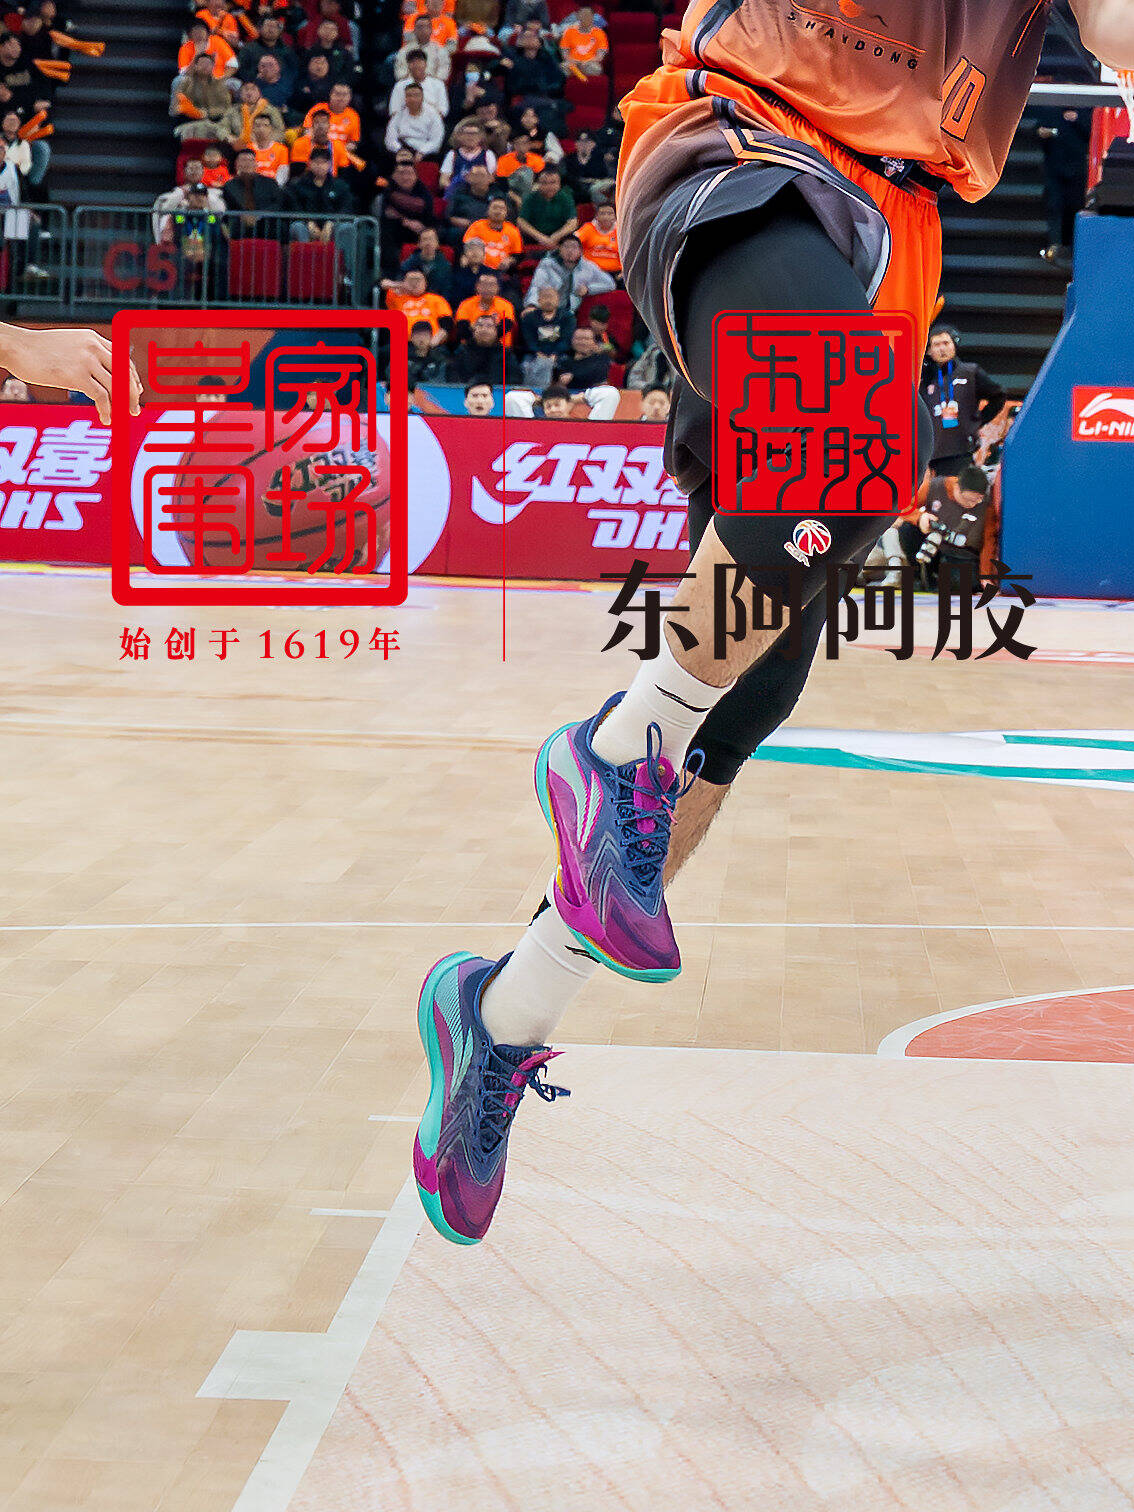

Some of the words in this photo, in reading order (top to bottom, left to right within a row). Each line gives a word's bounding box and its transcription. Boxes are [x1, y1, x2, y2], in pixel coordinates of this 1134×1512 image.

[103, 242, 178, 292] C5
[474, 441, 690, 522] 红双
[0, 489, 103, 531] HS
[586, 508, 691, 551] DH
